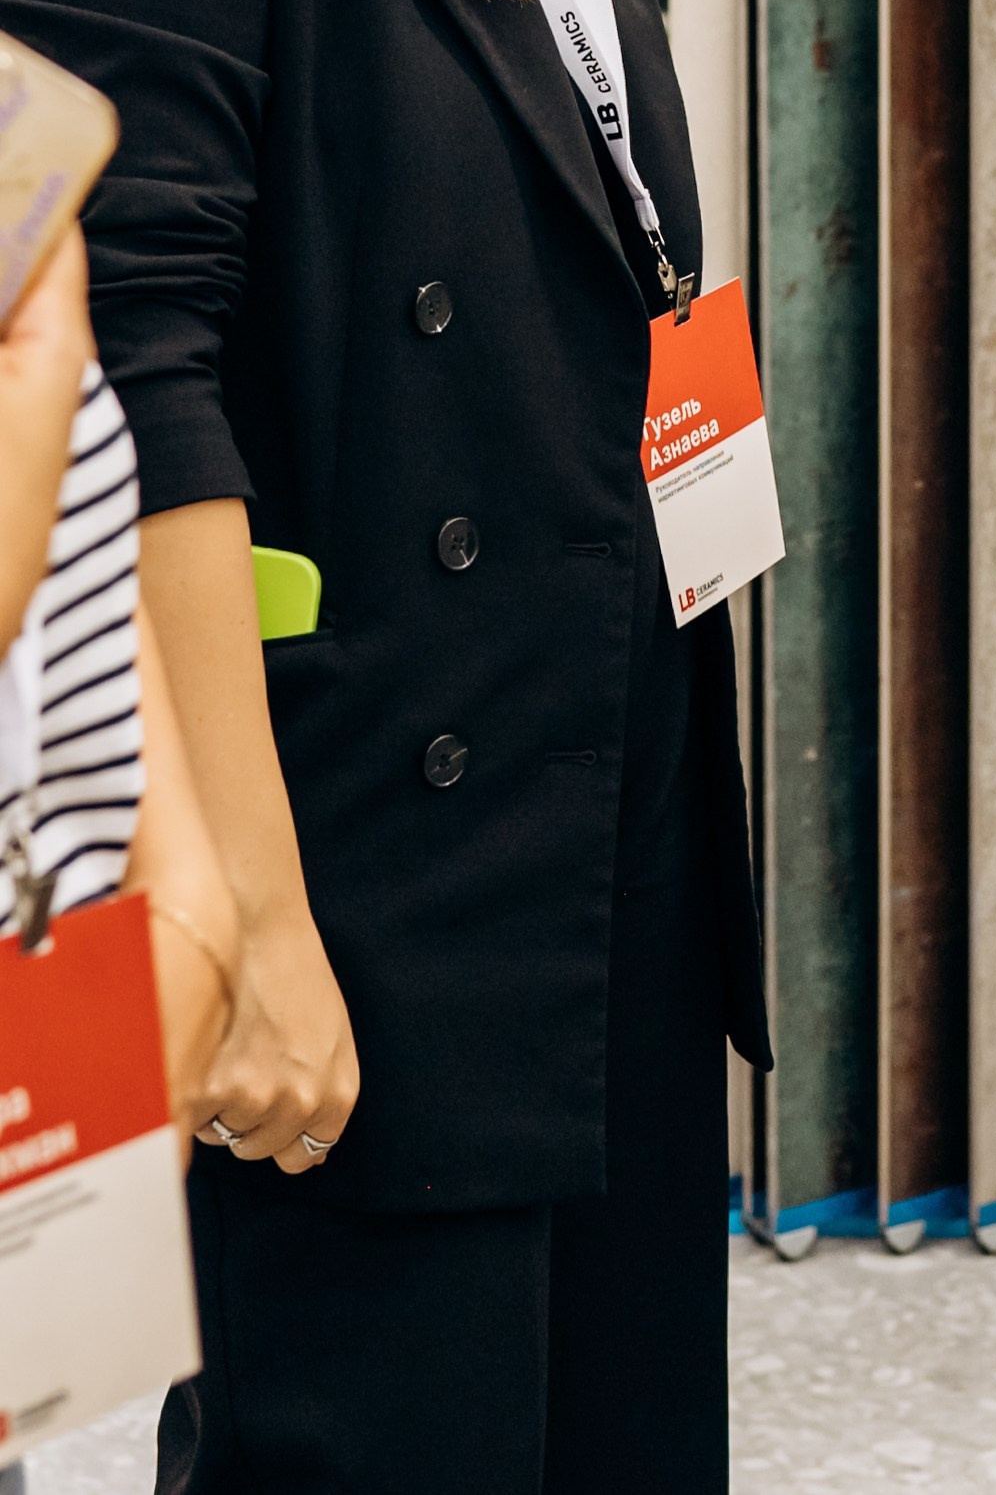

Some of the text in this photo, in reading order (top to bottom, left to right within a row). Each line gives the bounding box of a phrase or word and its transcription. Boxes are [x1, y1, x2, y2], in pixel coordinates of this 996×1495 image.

[560, 11, 623, 141] LB CERAMICS
[643, 398, 702, 442] Гузель
[650, 419, 720, 471] Азнаева
[678, 587, 696, 613] LB
[696, 572, 724, 596] CERAMICS
